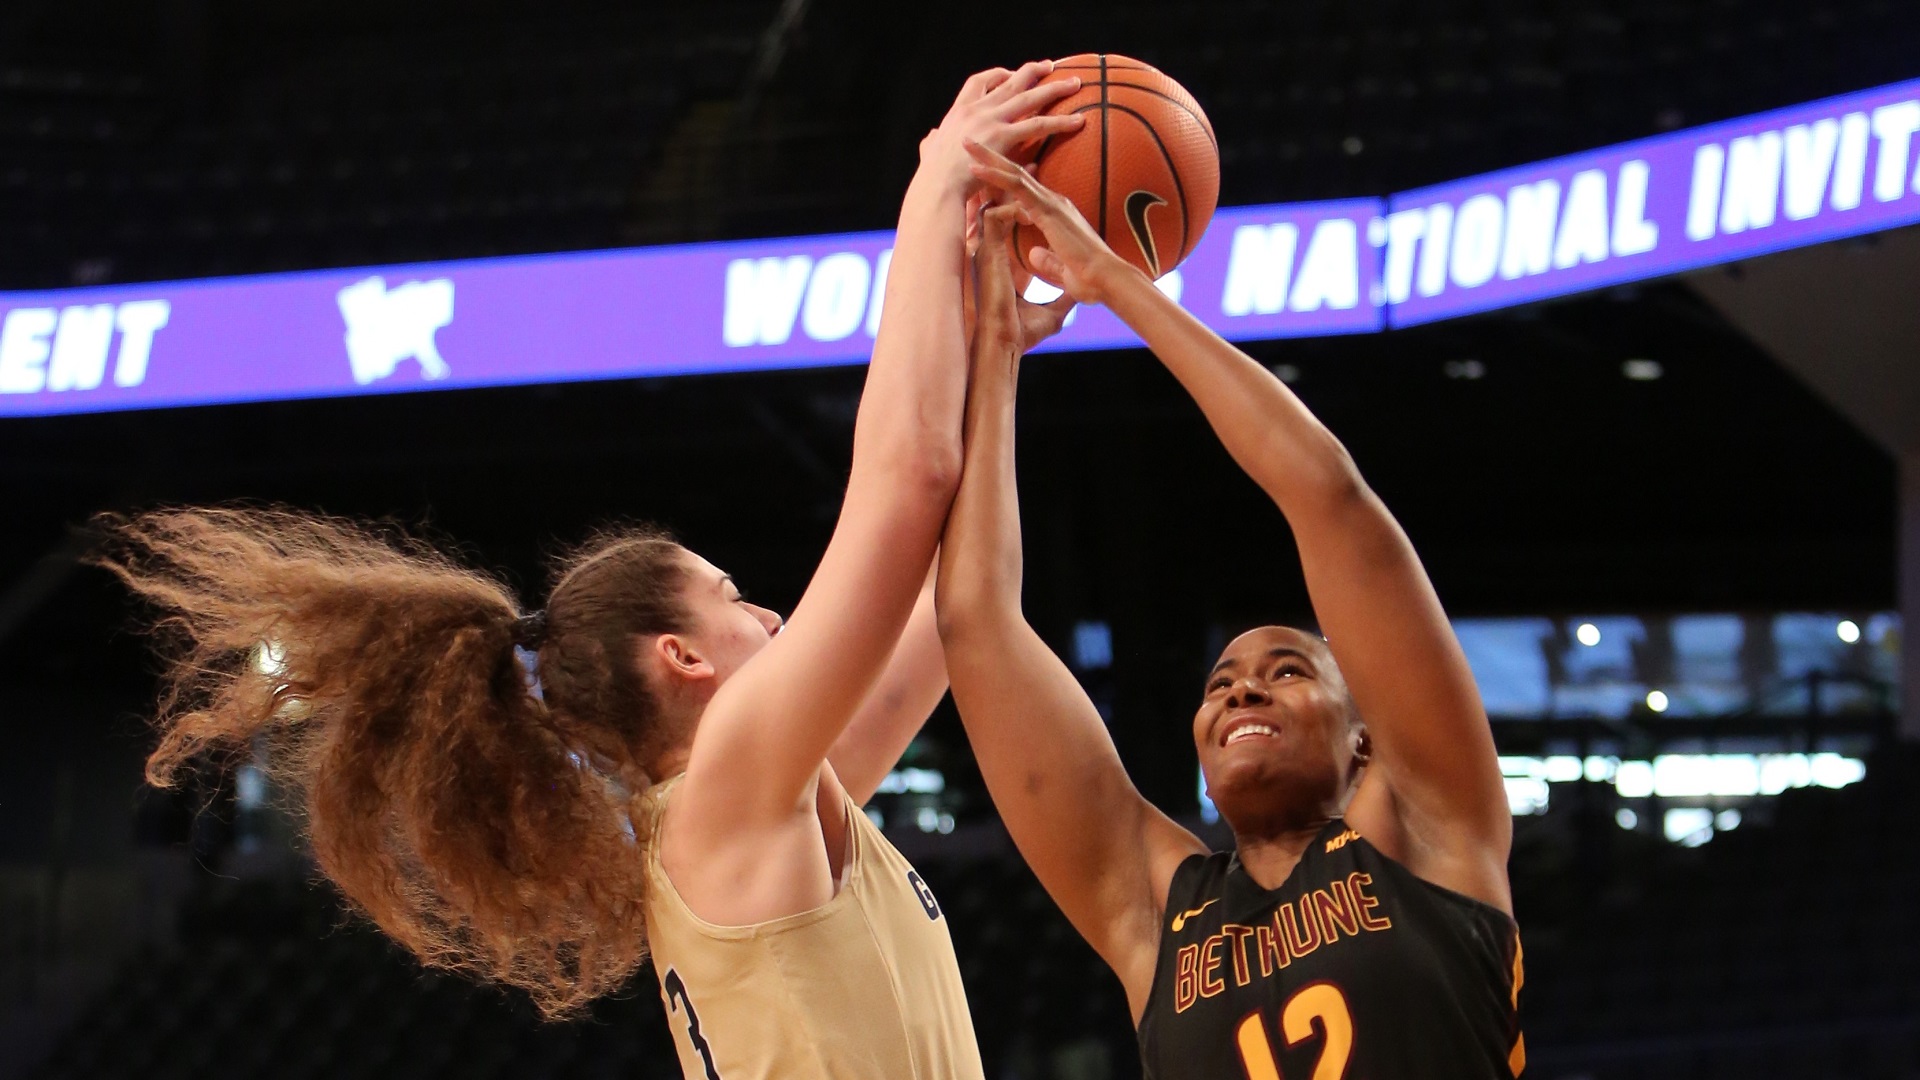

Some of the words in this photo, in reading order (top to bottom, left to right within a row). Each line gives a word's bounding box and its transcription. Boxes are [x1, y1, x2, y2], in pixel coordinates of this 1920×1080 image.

[1221, 158, 1659, 317] NATIONAL
[1686, 99, 1920, 242] INVIT
[1175, 872, 1392, 1014] BETHUNE
[1234, 981, 1357, 1080] 12
